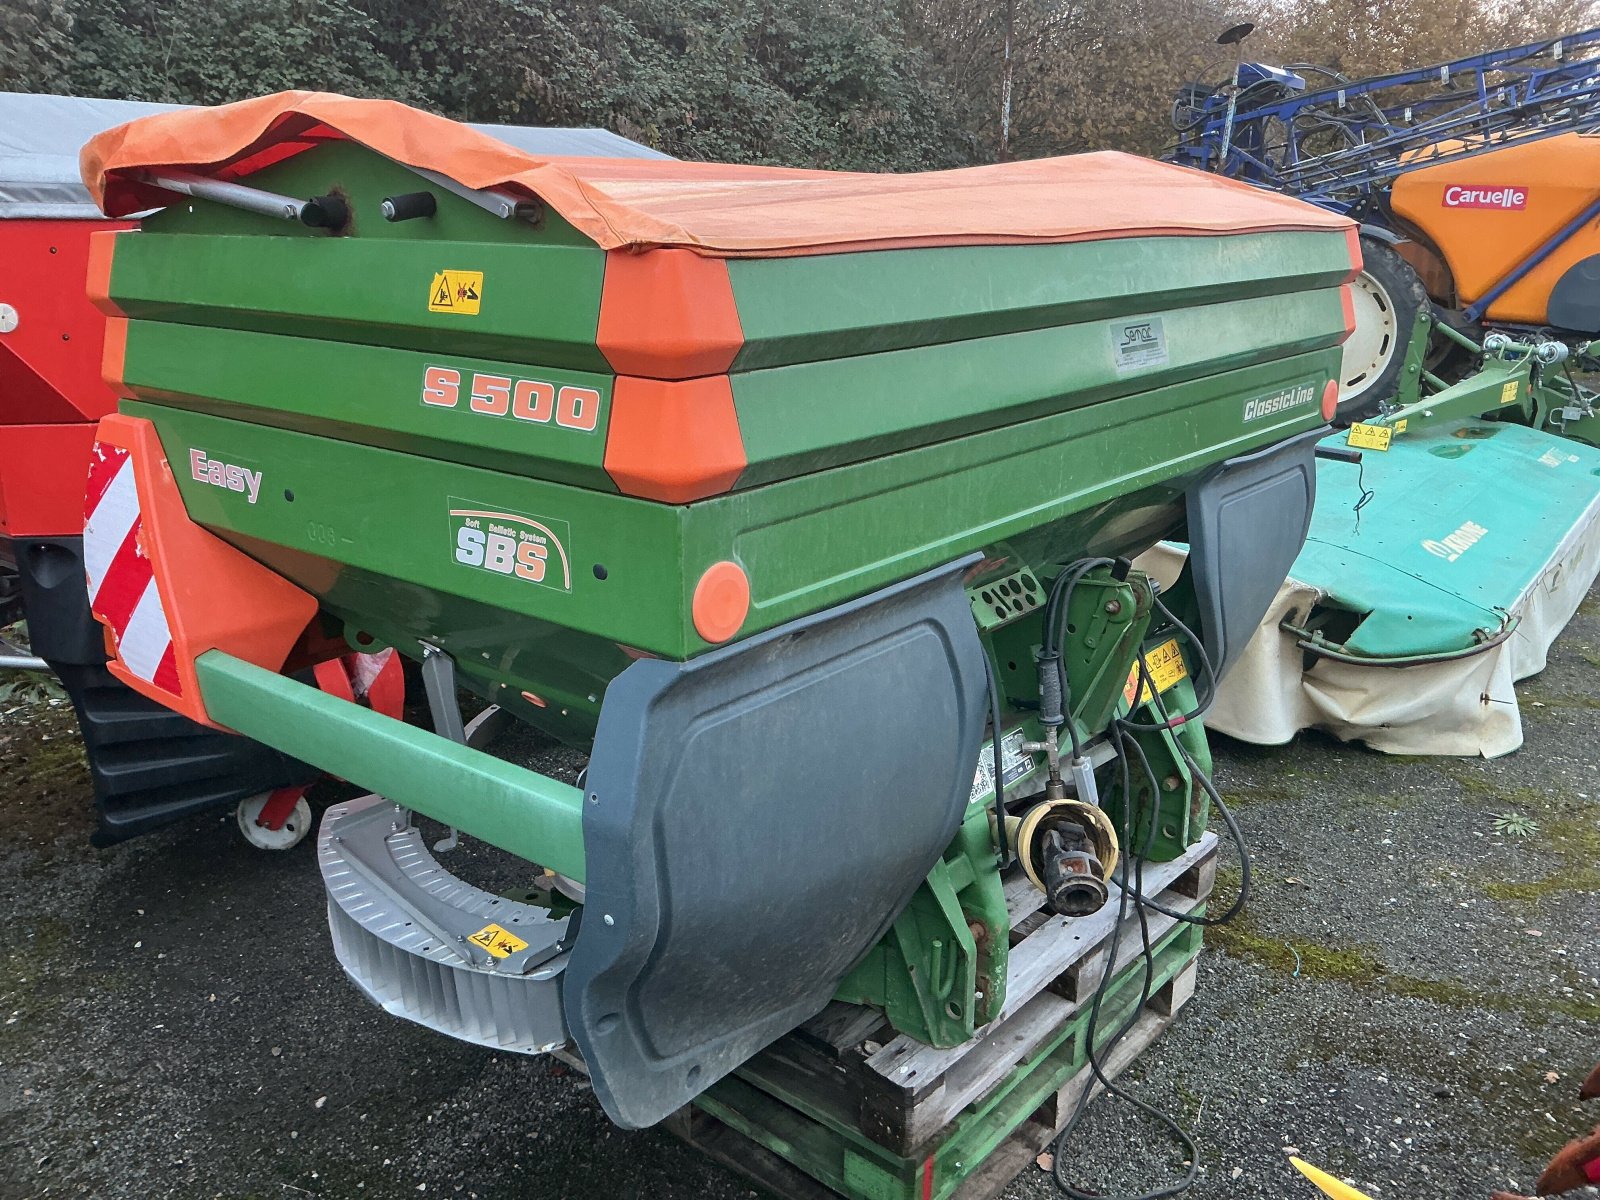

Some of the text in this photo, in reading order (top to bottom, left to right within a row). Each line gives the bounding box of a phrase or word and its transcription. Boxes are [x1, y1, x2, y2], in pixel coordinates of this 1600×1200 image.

[1445, 186, 1525, 208] Caruelle
[422, 366, 600, 432] S 500
[1244, 386, 1315, 421] ClassicLine
[189, 447, 263, 504] Easy
[465, 517, 547, 545] Soft Ballistic System
[1441, 520, 1489, 555] KRONE
[455, 526, 548, 582] SBS
